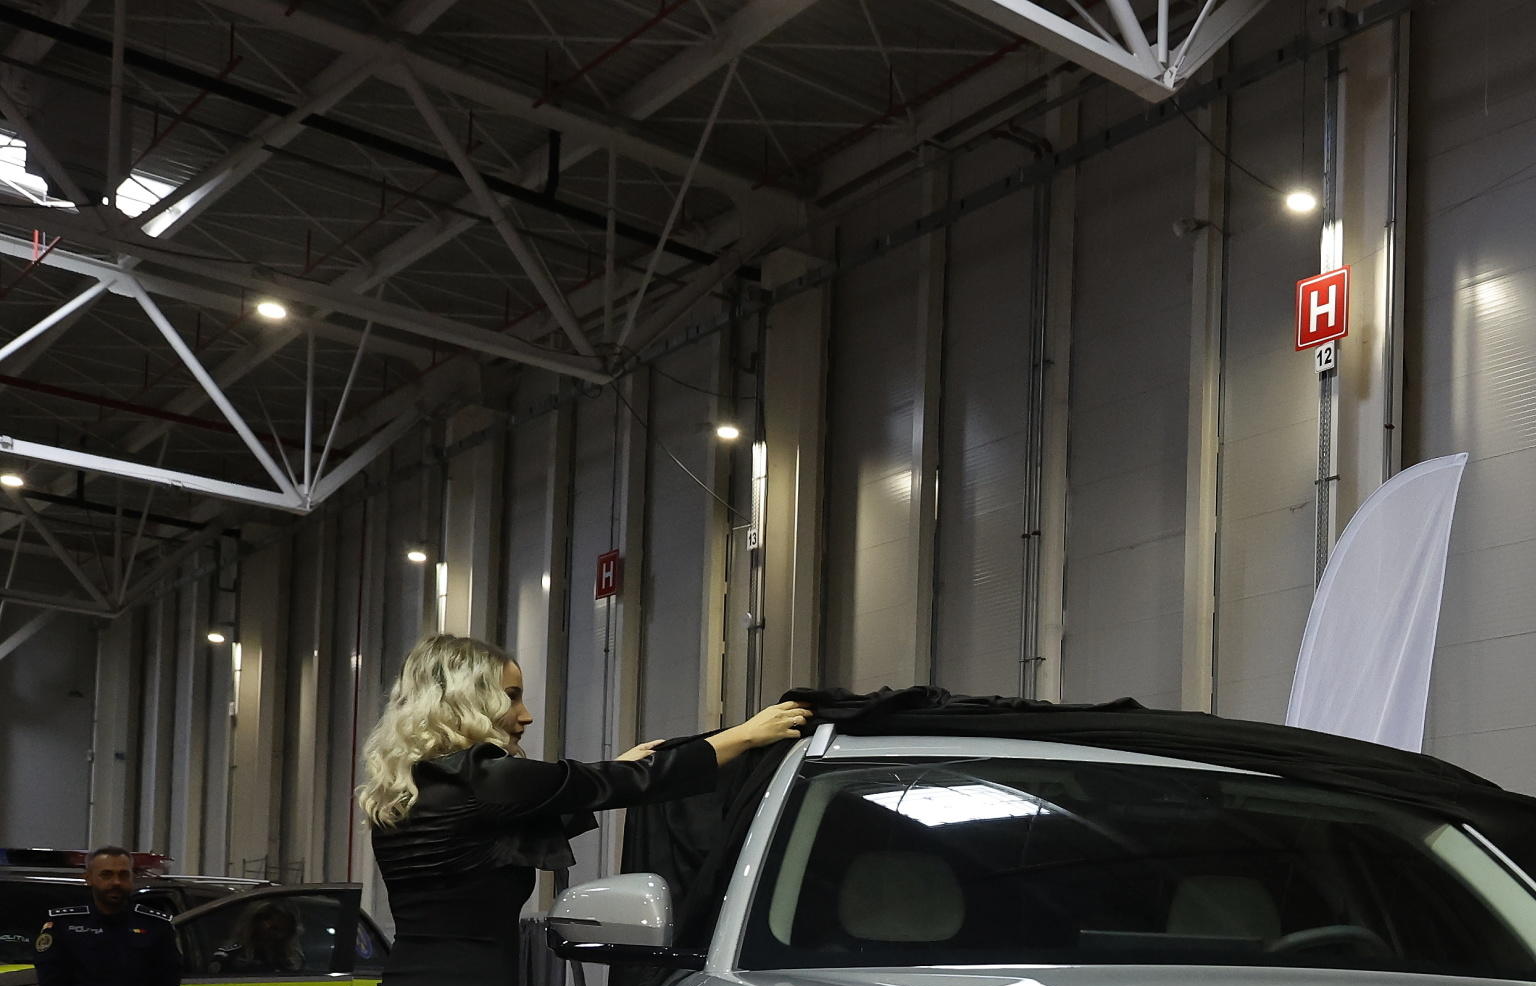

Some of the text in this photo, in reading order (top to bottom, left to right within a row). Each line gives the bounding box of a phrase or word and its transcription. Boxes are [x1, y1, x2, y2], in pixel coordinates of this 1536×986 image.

[1309, 284, 1336, 333] H
[1316, 347, 1332, 367] 12
[602, 560, 614, 590] H
